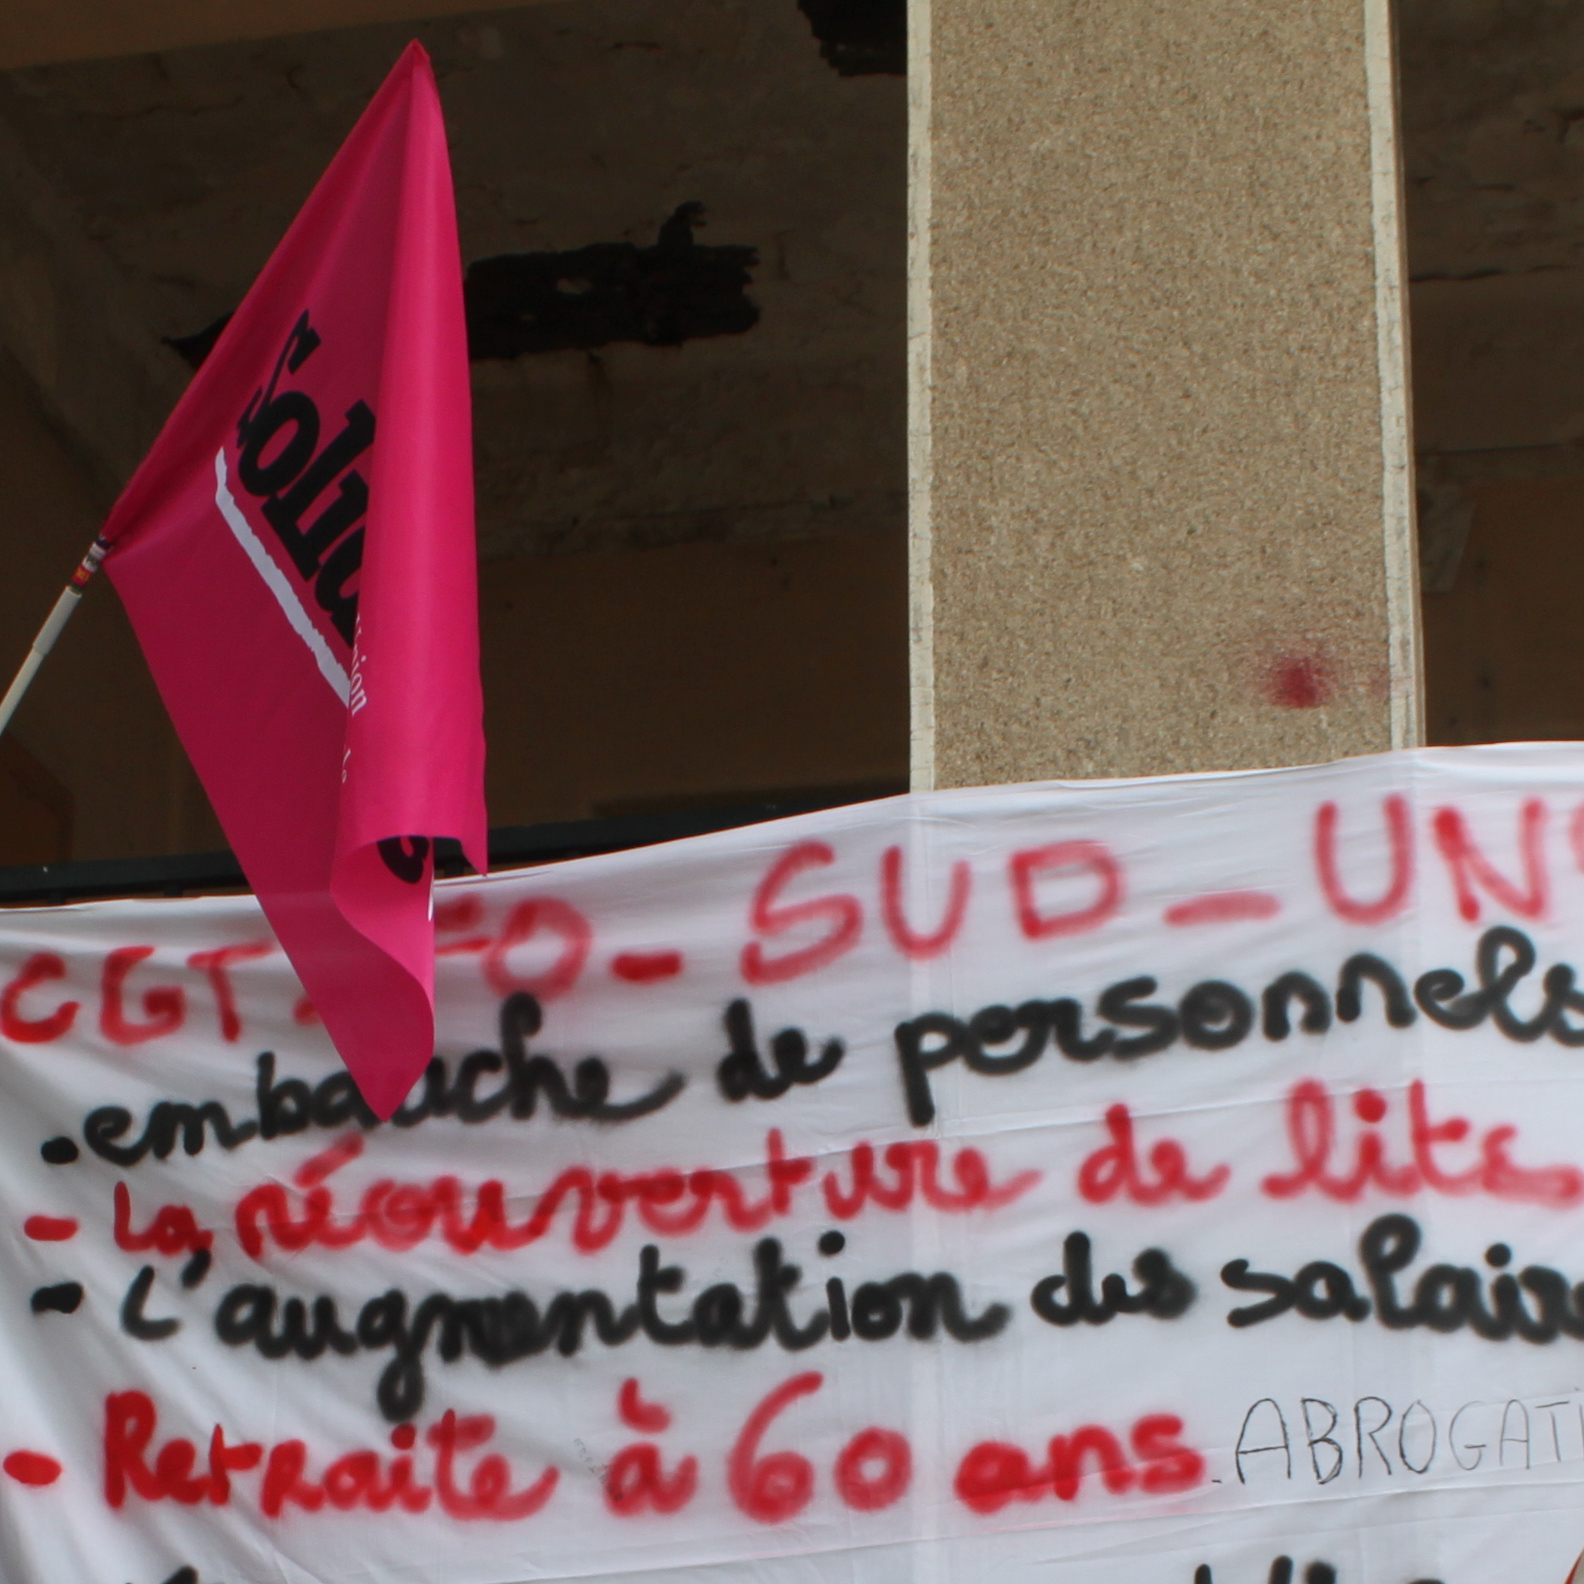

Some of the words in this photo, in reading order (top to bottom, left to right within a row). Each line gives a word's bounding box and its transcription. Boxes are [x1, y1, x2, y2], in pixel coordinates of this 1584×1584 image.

[739, 838, 1124, 987] SUD
[716, 998, 846, 1102] de
[1076, 1103, 1231, 1206] de
[101, 1388, 559, 1522] Retraite
[604, 1377, 699, 1518] à
[726, 1370, 913, 1525] 60
[952, 1412, 1206, 1515] ans
